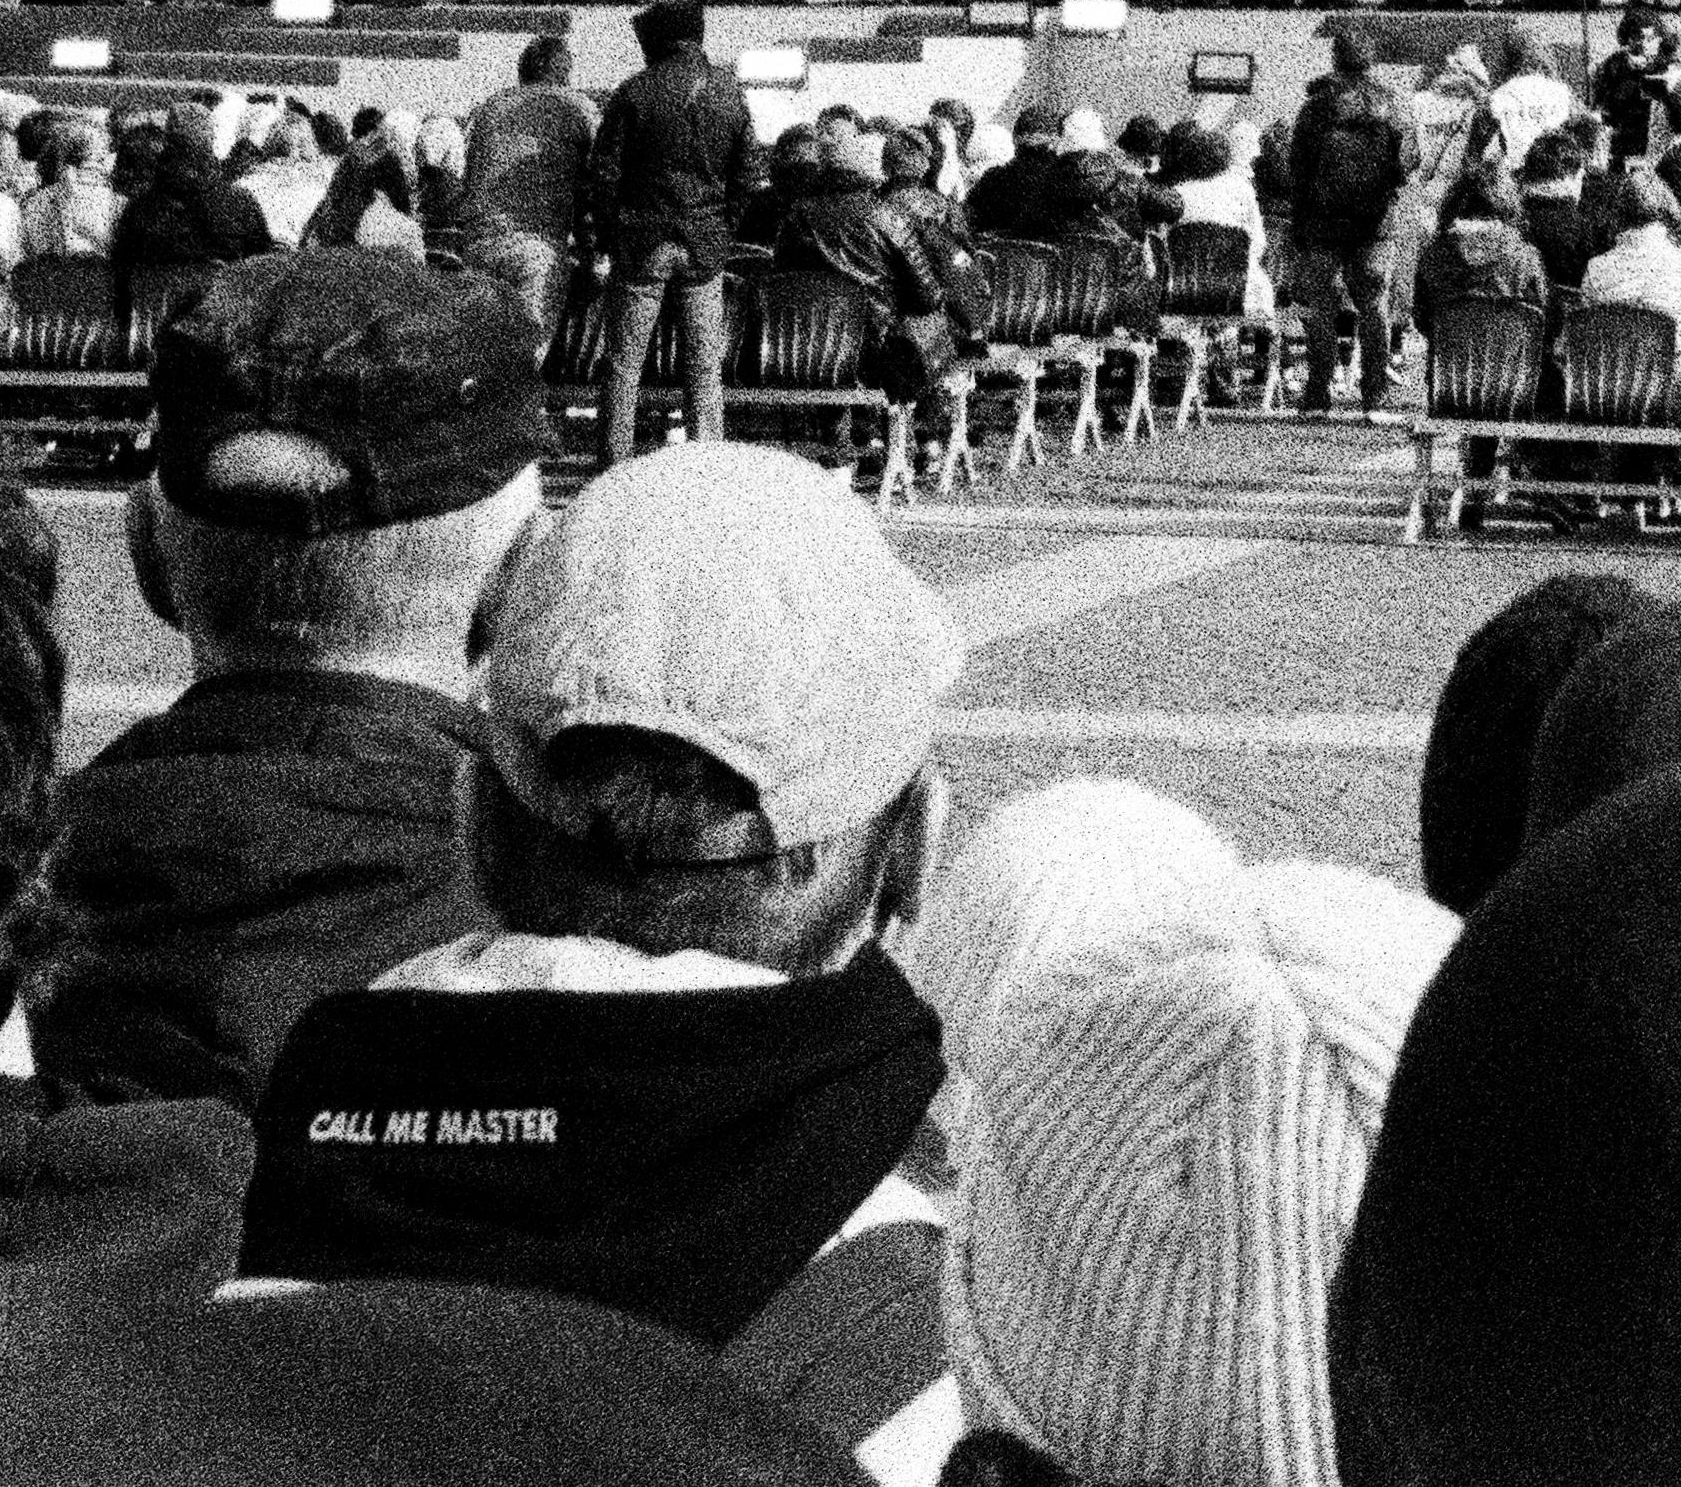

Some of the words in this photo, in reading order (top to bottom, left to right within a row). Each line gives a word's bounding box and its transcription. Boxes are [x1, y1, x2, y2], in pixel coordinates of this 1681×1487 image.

[308, 1109, 375, 1143] CALL
[383, 1109, 428, 1143] ME
[436, 1108, 558, 1143] MASTER
